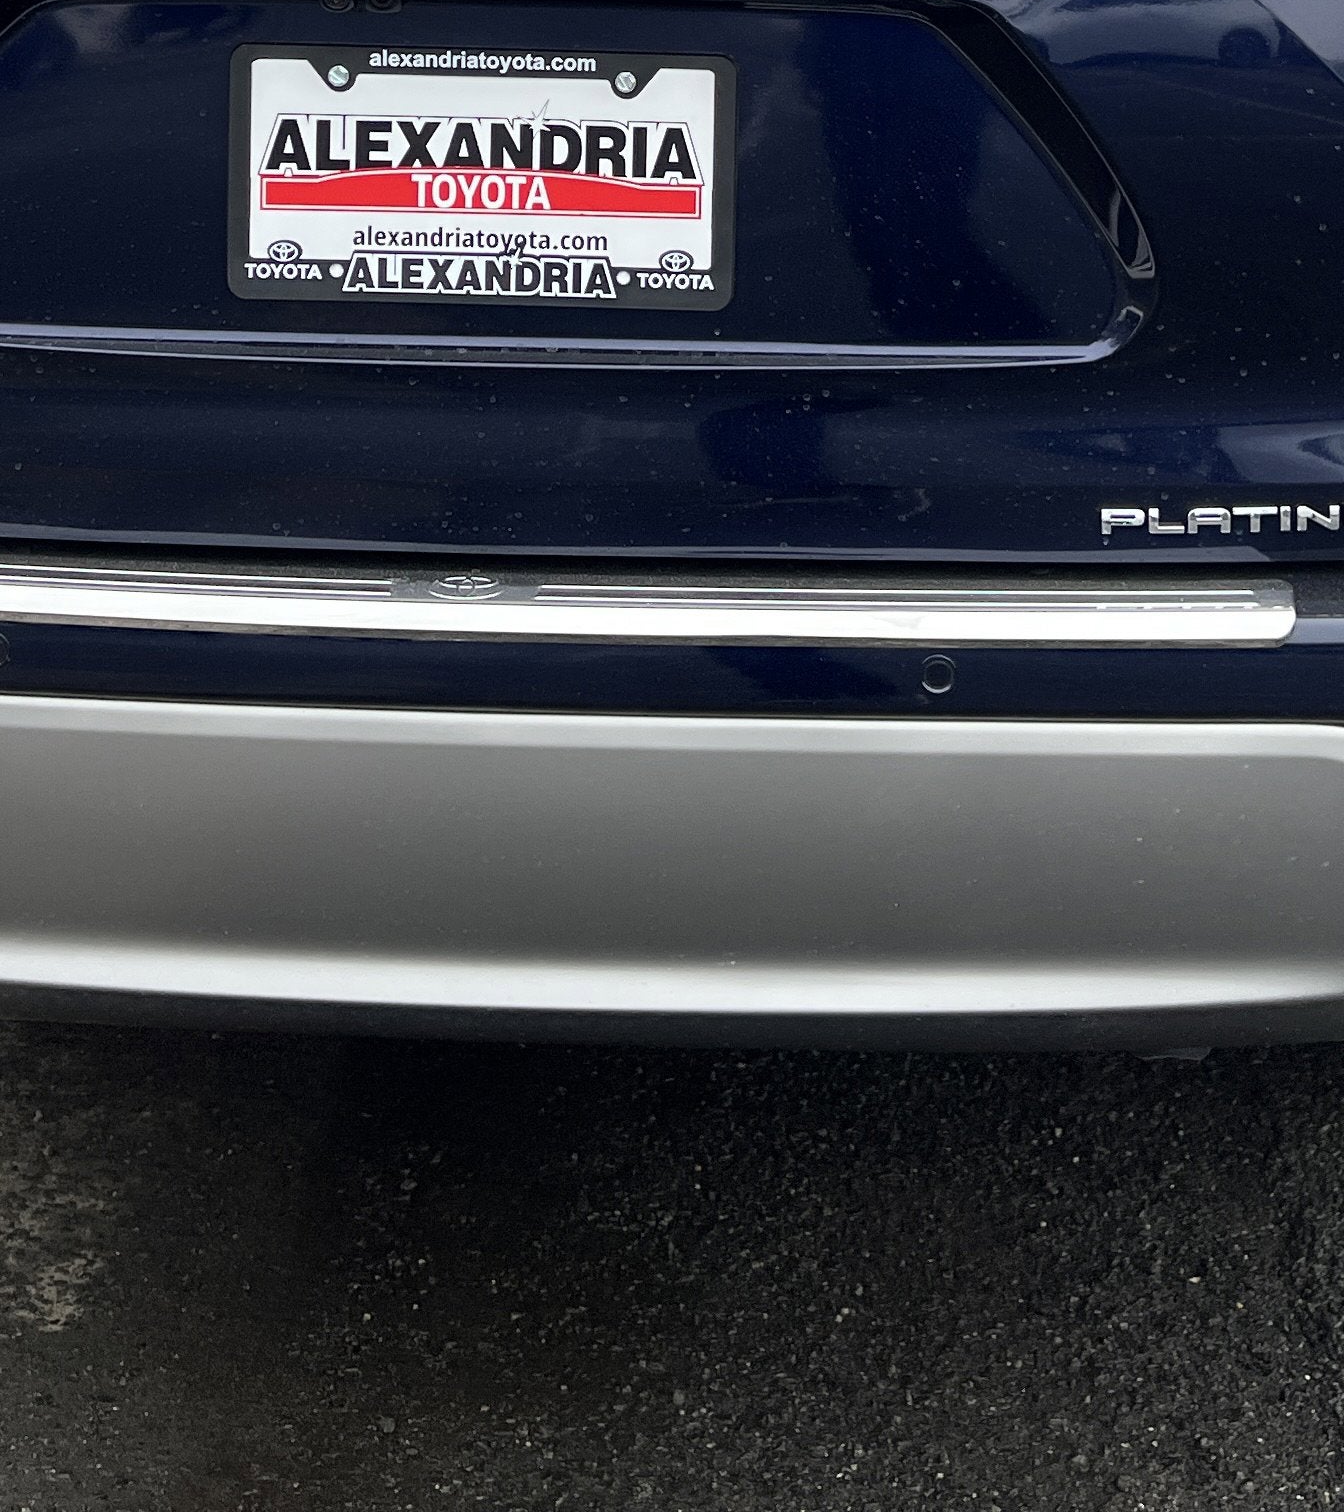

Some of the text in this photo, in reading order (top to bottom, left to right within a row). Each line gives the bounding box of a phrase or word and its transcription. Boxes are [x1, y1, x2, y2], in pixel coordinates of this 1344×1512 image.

[369, 50, 596, 73] alexandriatoyota.com
[264, 117, 699, 181] ALEXANDRIA
[411, 174, 551, 211] TOYOTA
[353, 226, 607, 254] alexandriatoyota.com
[244, 255, 715, 297] TOYOTA ALEXANDRIA TOYOTA
